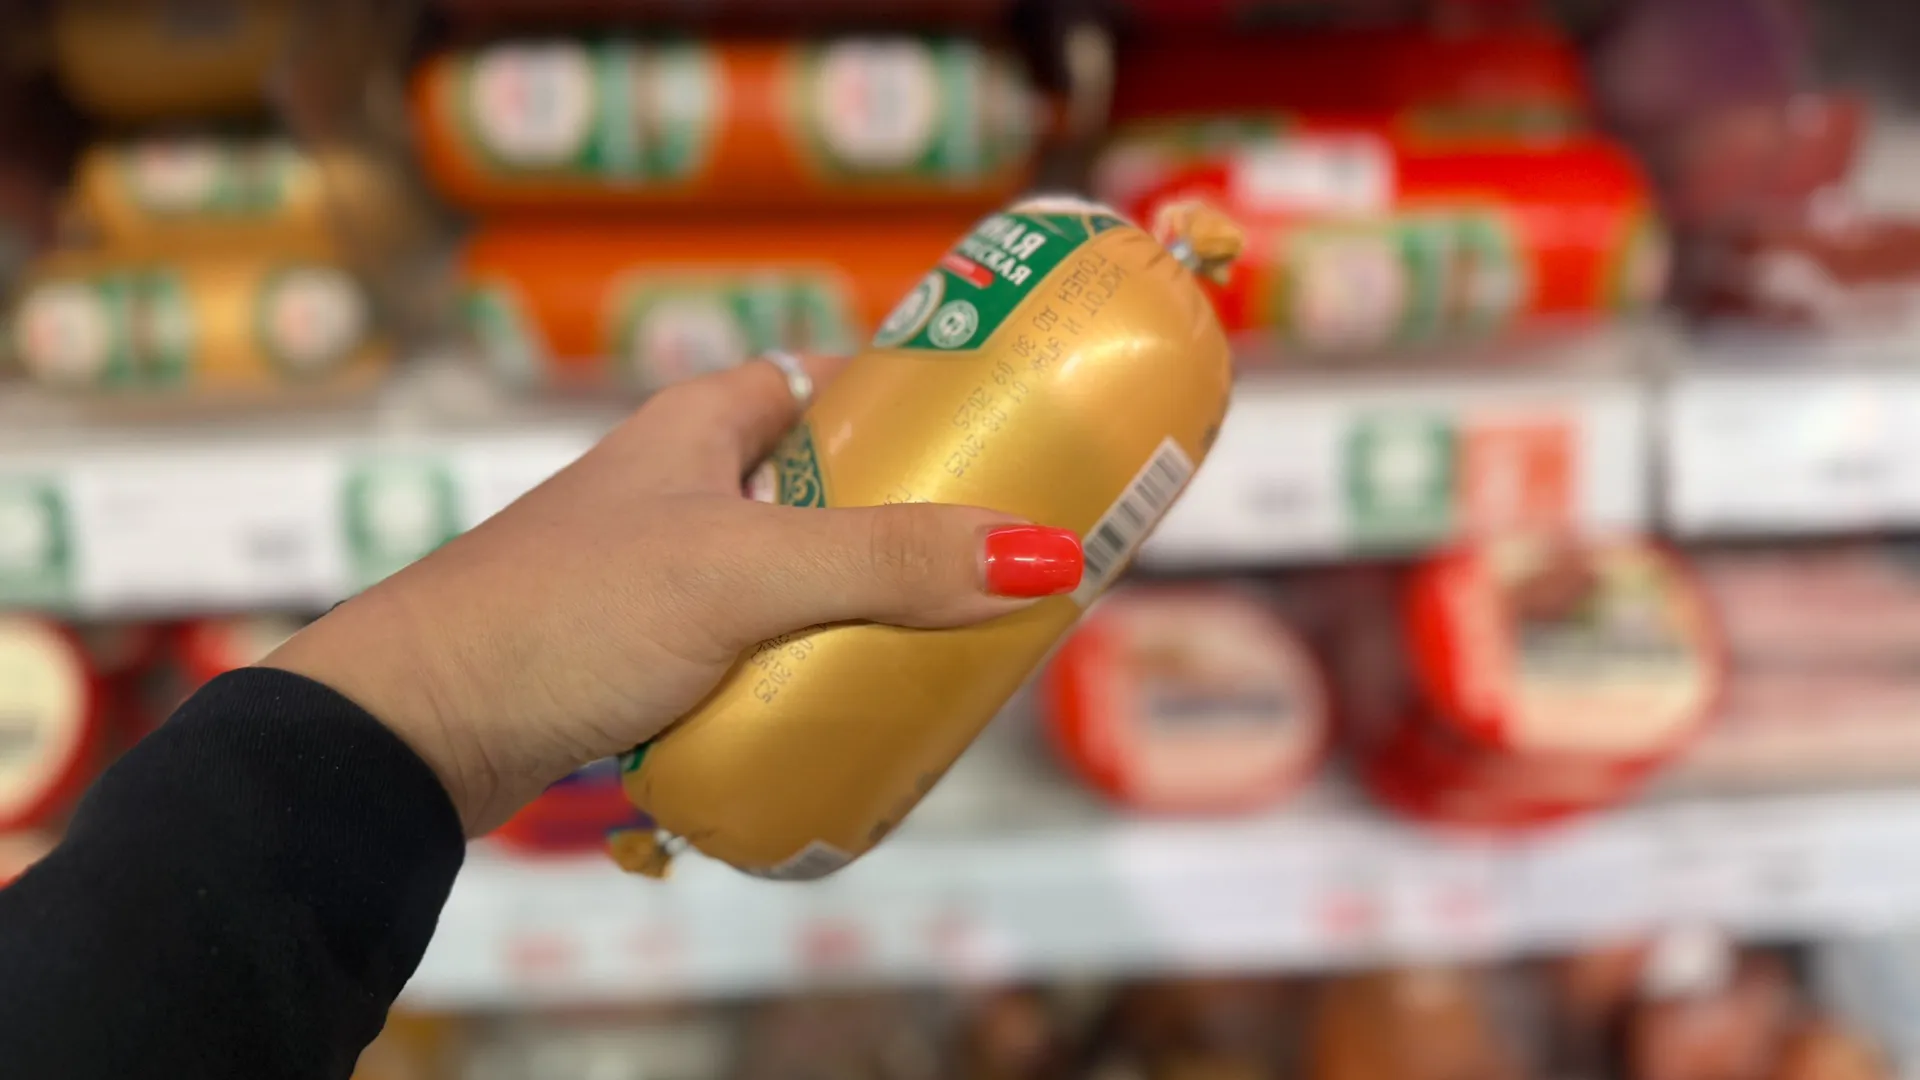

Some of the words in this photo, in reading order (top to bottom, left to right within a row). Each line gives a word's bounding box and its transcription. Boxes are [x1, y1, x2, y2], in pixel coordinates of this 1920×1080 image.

[1057, 249, 1109, 306] ГОДЕН
[1080, 262, 1130, 317] ИЗГОТ
[1032, 306, 1060, 335] ДО
